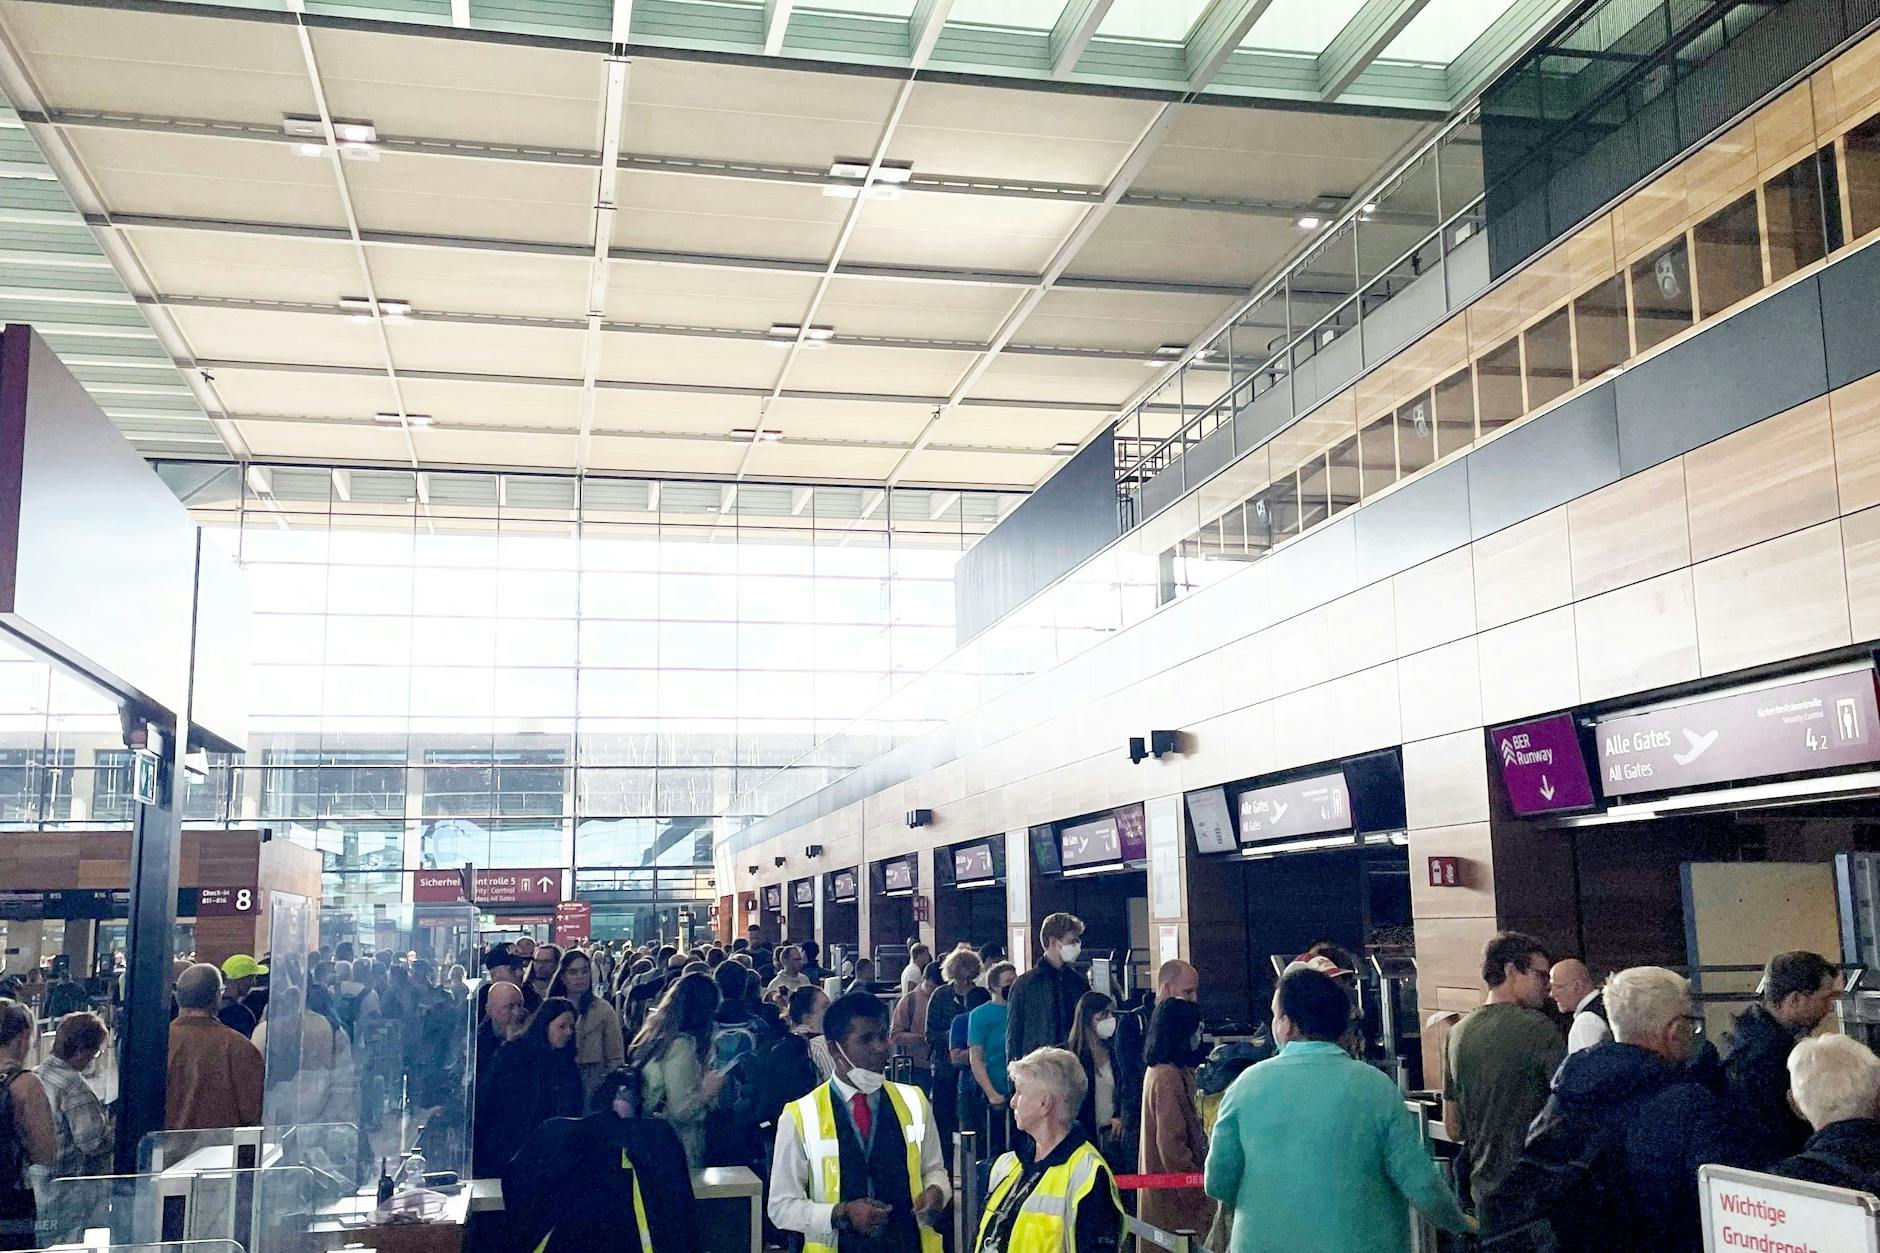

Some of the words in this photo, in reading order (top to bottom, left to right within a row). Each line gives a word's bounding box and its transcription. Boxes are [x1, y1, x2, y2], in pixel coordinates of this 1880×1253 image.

[1512, 733, 1531, 750] BER
[1605, 733, 1630, 757] Alle
[1633, 729, 1672, 751] Gates
[1516, 748, 1552, 766] Runway
[1609, 764, 1623, 783] All
[1624, 762, 1653, 780] Gates
[235, 888, 252, 911] 8
[1720, 1193, 1786, 1227] Wichtige
